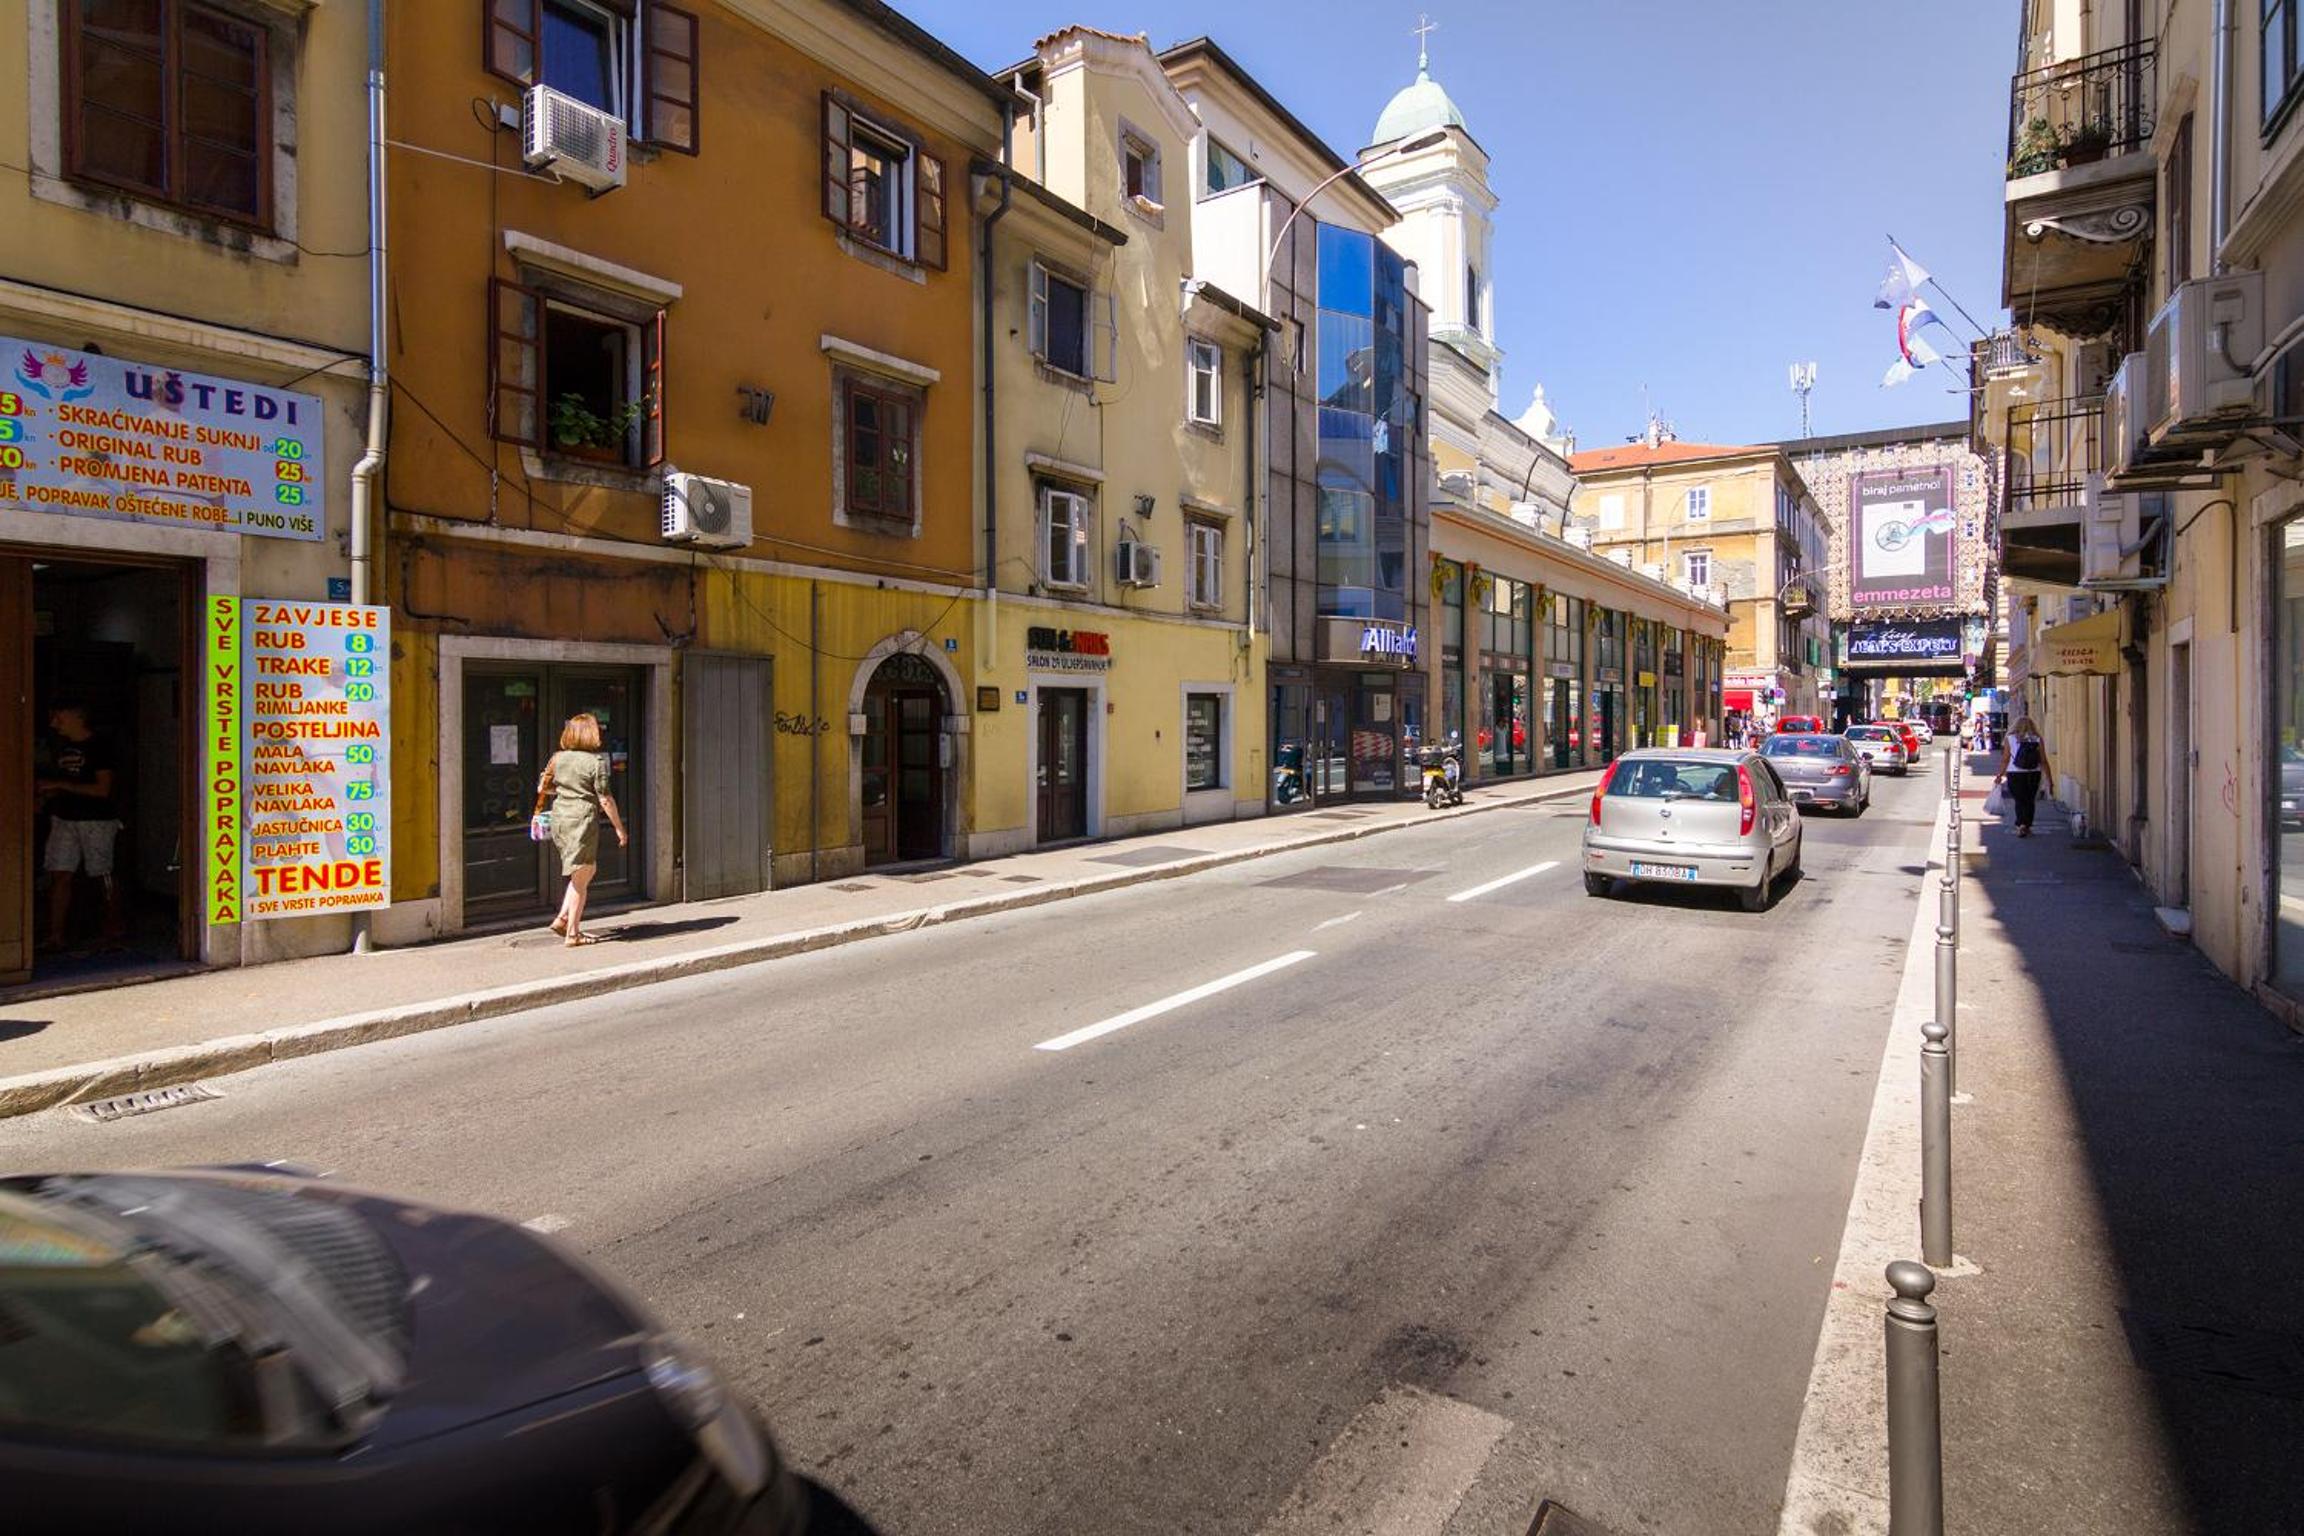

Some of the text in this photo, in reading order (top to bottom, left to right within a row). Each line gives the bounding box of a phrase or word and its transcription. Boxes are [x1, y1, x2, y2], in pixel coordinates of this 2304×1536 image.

[125, 369, 298, 426] UŠTEDI
[58, 404, 189, 440] SKRAĆIVANJE
[196, 427, 261, 452] SUKNJI
[276, 438, 302, 459] 20
[59, 429, 157, 461] ORIGINAL
[163, 445, 202, 466] RUB
[278, 462, 302, 481] 25
[60, 456, 302, 505] PROMJENA PATENTA 25
[26, 485, 110, 509] POPRAVAK
[115, 493, 188, 518] OŠTEĆENE
[246, 511, 285, 529] PUNO
[288, 514, 314, 533] VIŠE
[1853, 584, 1952, 603] emmezeta
[255, 606, 377, 628] ZAVJESE
[255, 630, 367, 652] RUB 8
[256, 657, 371, 676] TRAKE 12
[255, 682, 372, 701] RUB 20
[255, 701, 348, 715] RIMLJANKE
[252, 721, 380, 739] POSTELJINA
[213, 598, 236, 921] SVE VRSTE POPRAVAKA
[253, 745, 304, 759] MALA
[347, 745, 373, 763] 50
[254, 760, 336, 775] NAVLAKA
[253, 783, 314, 796] VELIKA
[347, 782, 373, 800] 75
[254, 798, 336, 813] NAVLAKA
[253, 813, 374, 836] JASTUČNICA 30
[255, 842, 321, 858] PLAHTE
[347, 837, 374, 854] 30
[253, 861, 382, 895] TENDE
[258, 900, 279, 913] SVE
[282, 897, 317, 911] VRSTE
[319, 891, 385, 907] POPRAVAKA
